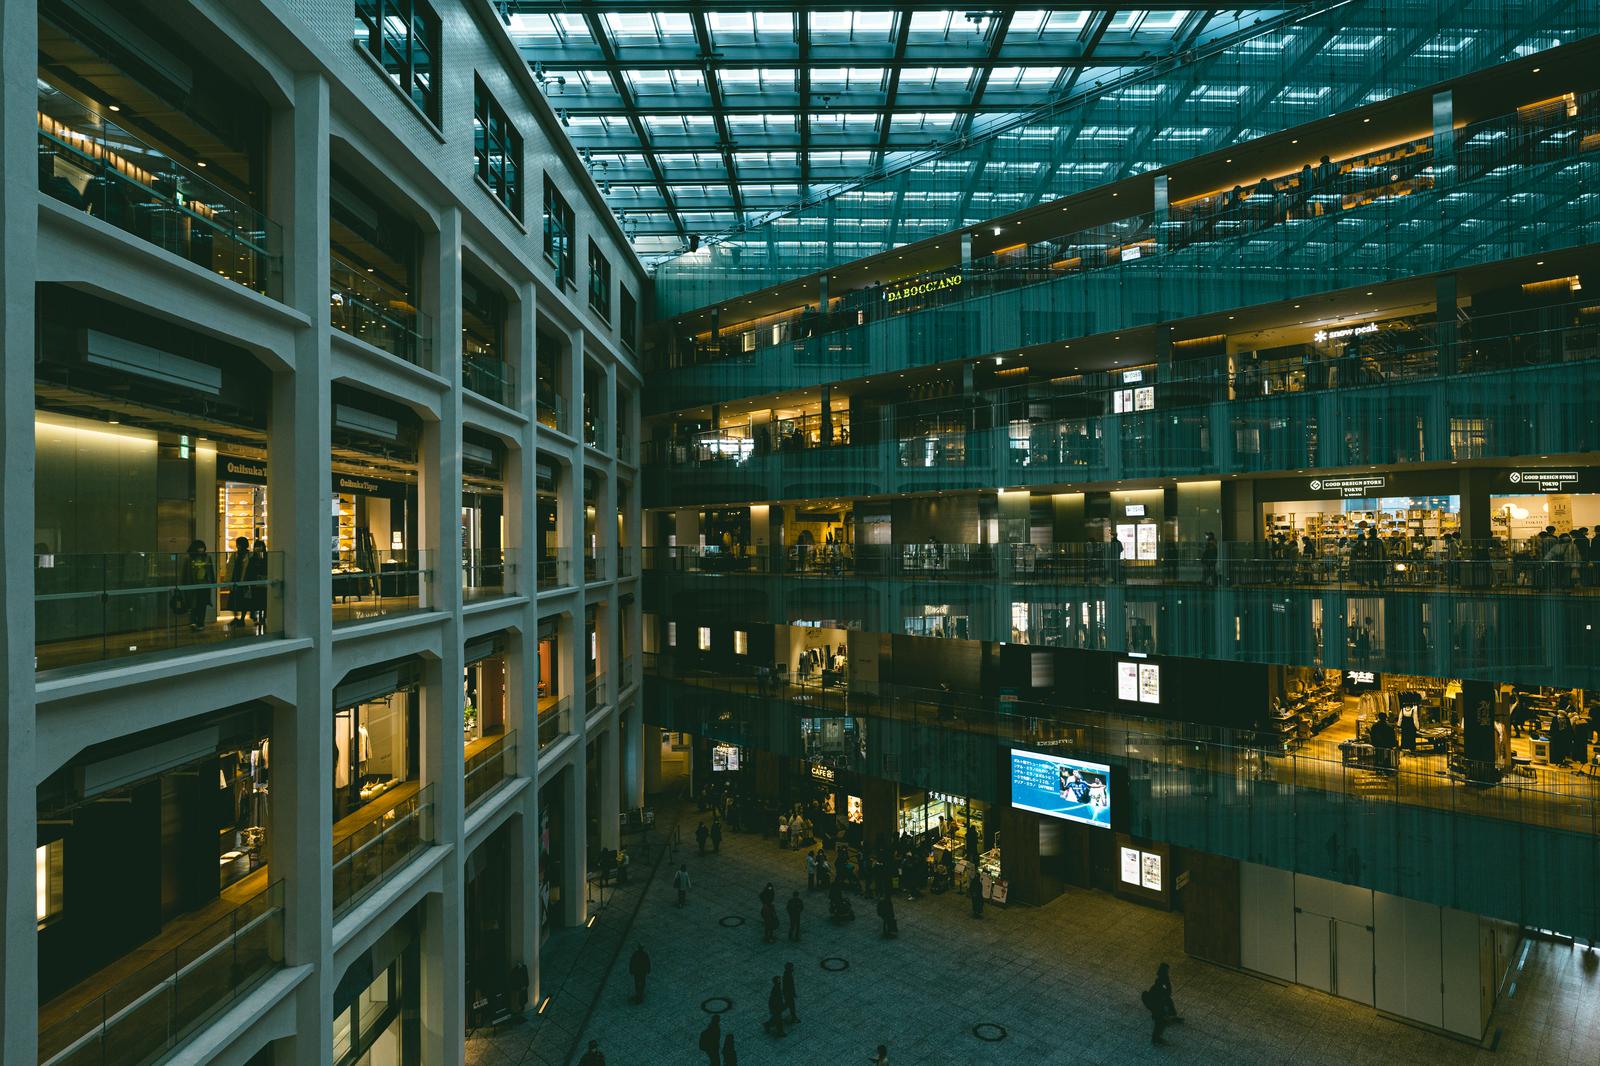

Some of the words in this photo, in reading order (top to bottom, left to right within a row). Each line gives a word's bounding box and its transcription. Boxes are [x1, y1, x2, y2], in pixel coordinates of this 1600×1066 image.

[888, 291, 902, 302] DA
[903, 275, 962, 298] BOCCIANO
[1328, 329, 1354, 338] snow
[1354, 322, 1378, 336] peak
[228, 462, 262, 476] Onitsuka
[363, 482, 378, 492] Tiger
[811, 767, 826, 777] CAFE
